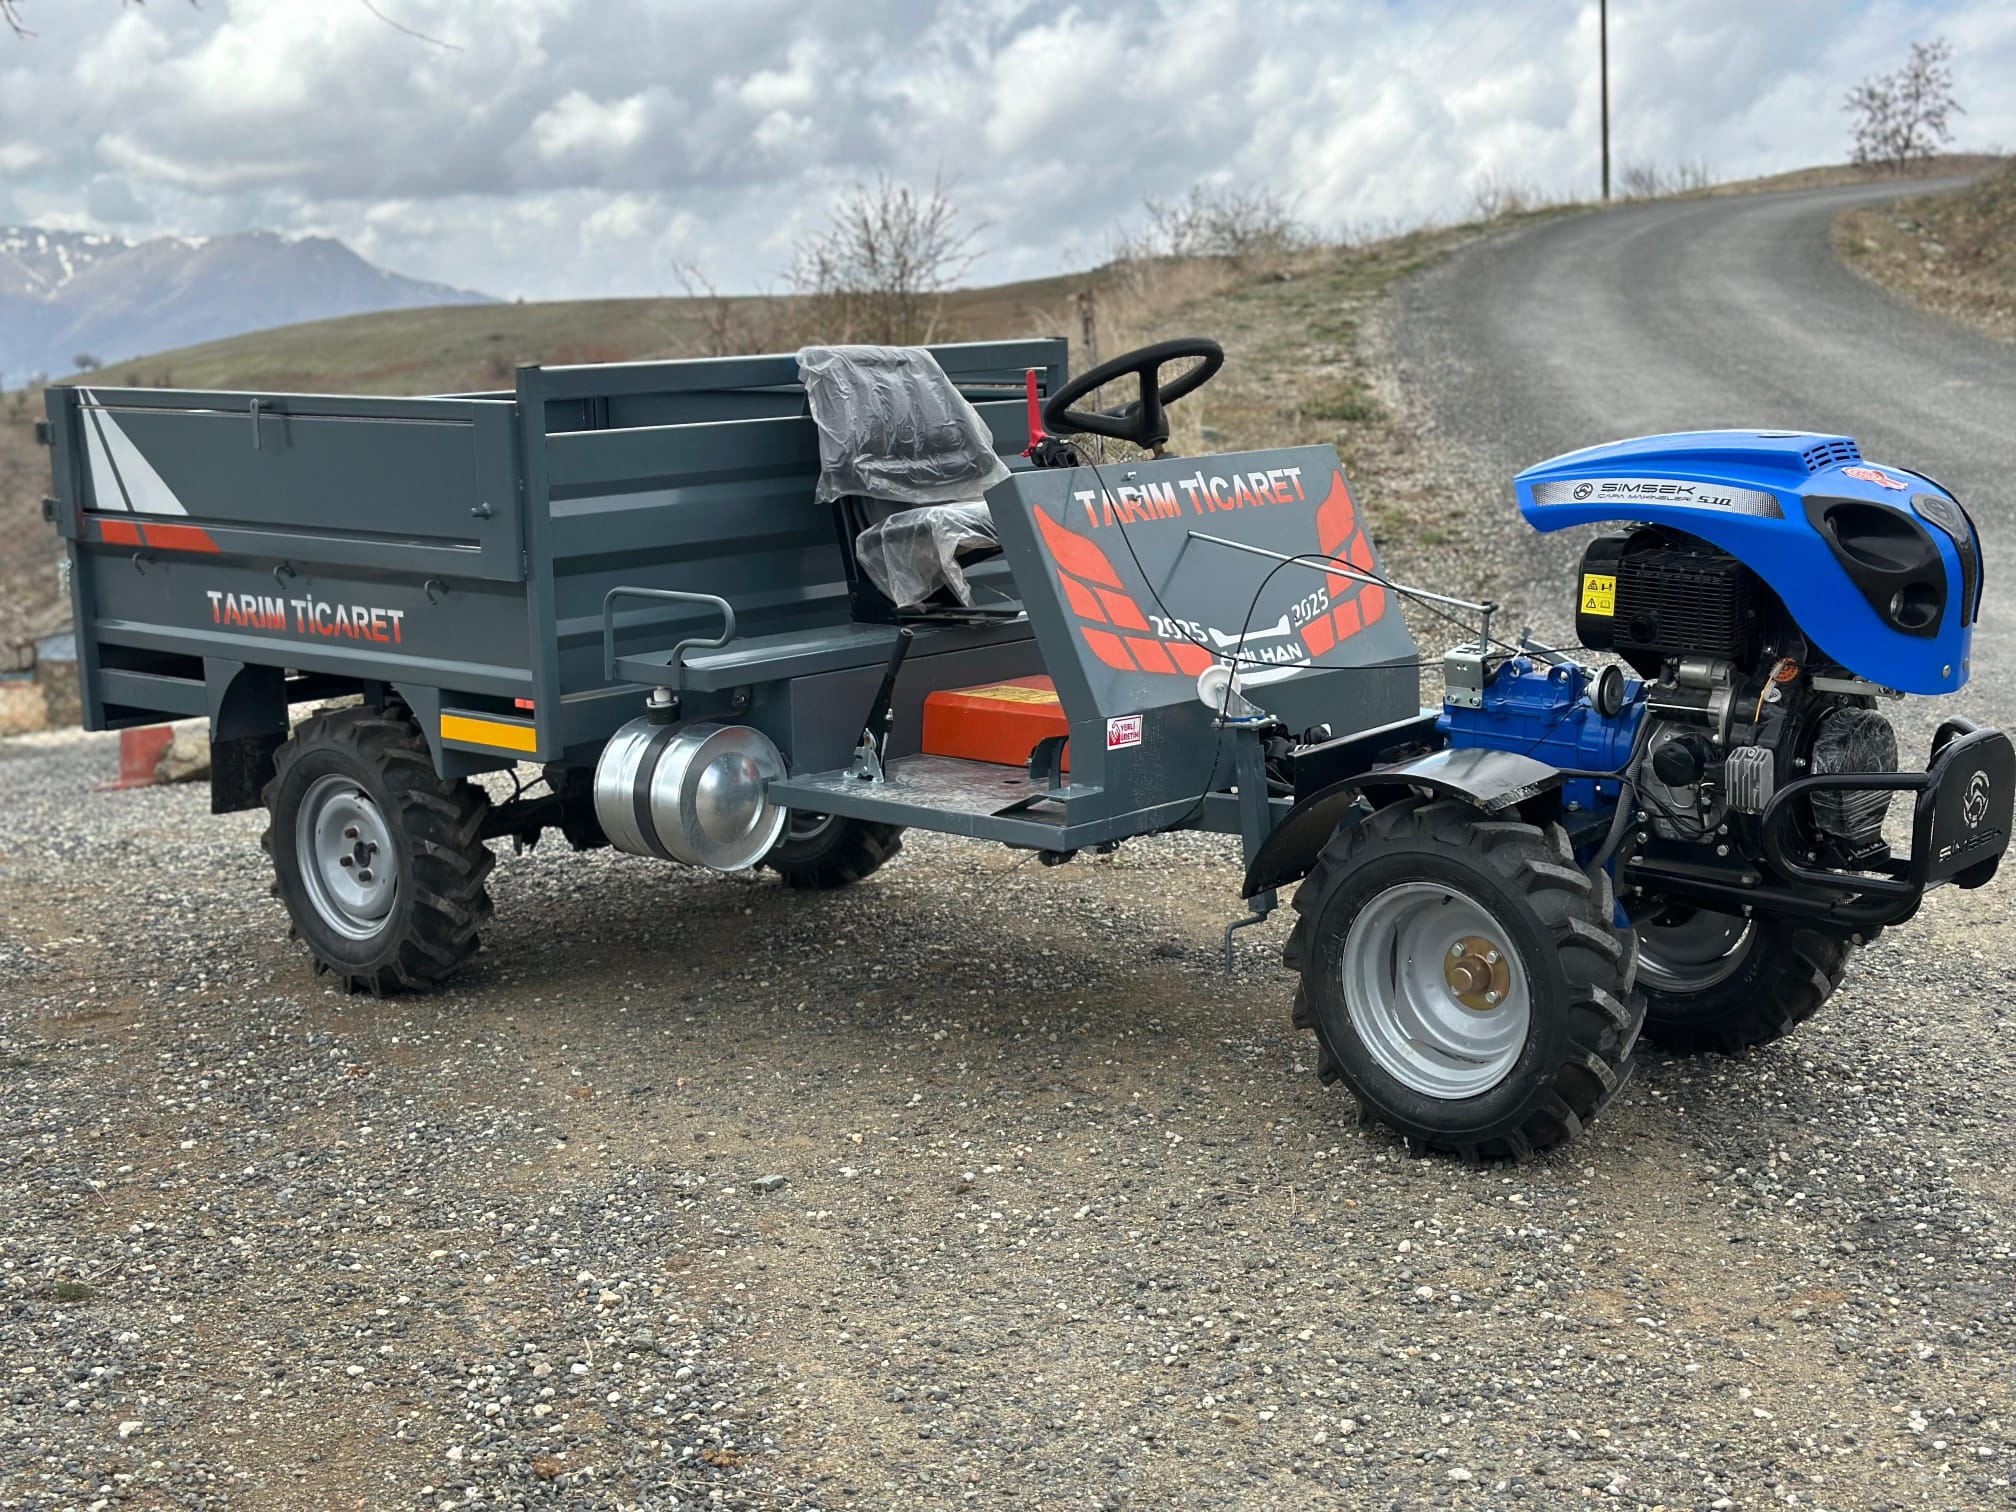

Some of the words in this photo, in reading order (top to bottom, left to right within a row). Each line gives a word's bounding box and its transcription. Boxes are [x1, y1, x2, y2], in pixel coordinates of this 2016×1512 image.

[1073, 481, 1182, 528] TARIM
[206, 590, 287, 631] TARIM
[1291, 587, 1329, 627] 2025
[1149, 616, 1208, 642] 2025
